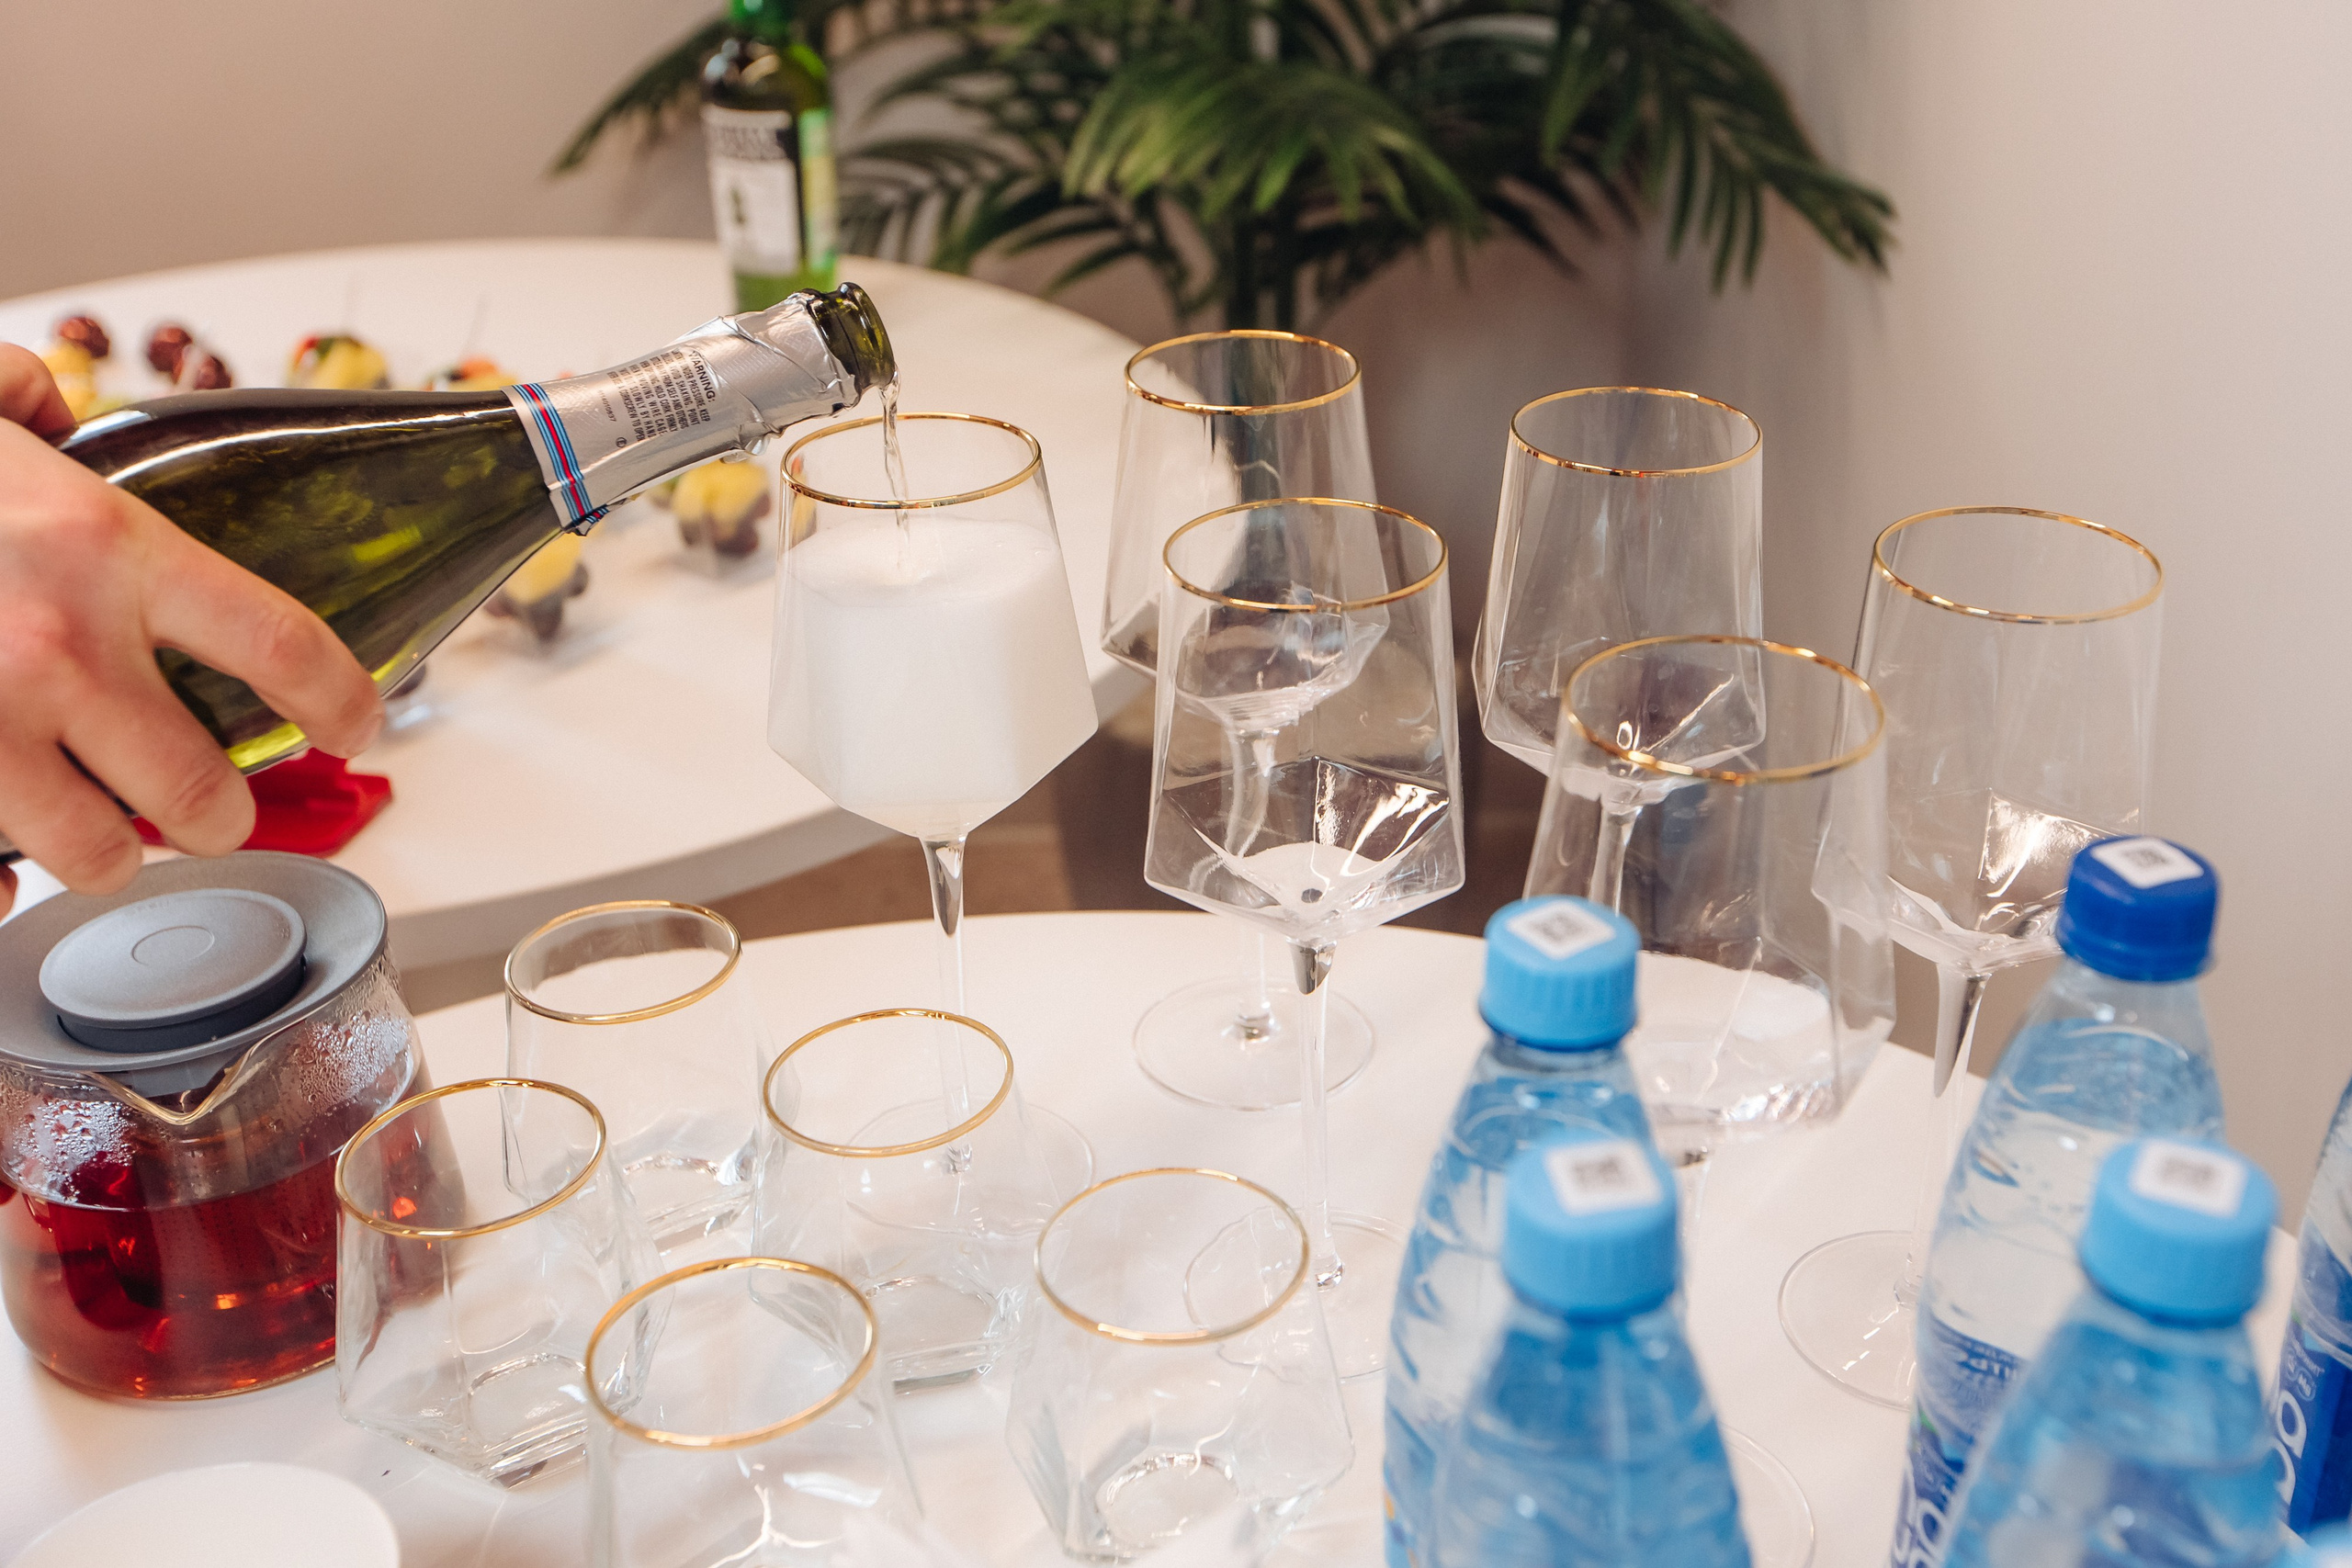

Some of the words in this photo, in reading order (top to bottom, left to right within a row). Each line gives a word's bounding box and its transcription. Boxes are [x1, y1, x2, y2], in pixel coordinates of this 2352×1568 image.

[661, 375, 673, 389] FROM
[653, 385, 665, 399] HOLD
[667, 387, 678, 400] SELF
[618, 389, 638, 419] CORKSCREW
[631, 419, 641, 427] TO
[629, 386, 647, 410] SLOWLY
[640, 411, 650, 420] BY
[649, 400, 661, 417] WIRE
[660, 399, 671, 413] CORK
[672, 399, 682, 411] AND
[665, 413, 679, 433] FIRMLY
[675, 410, 688, 429] OTHERS
[687, 409, 700, 426] POINT
[699, 408, 710, 423] KEEP
